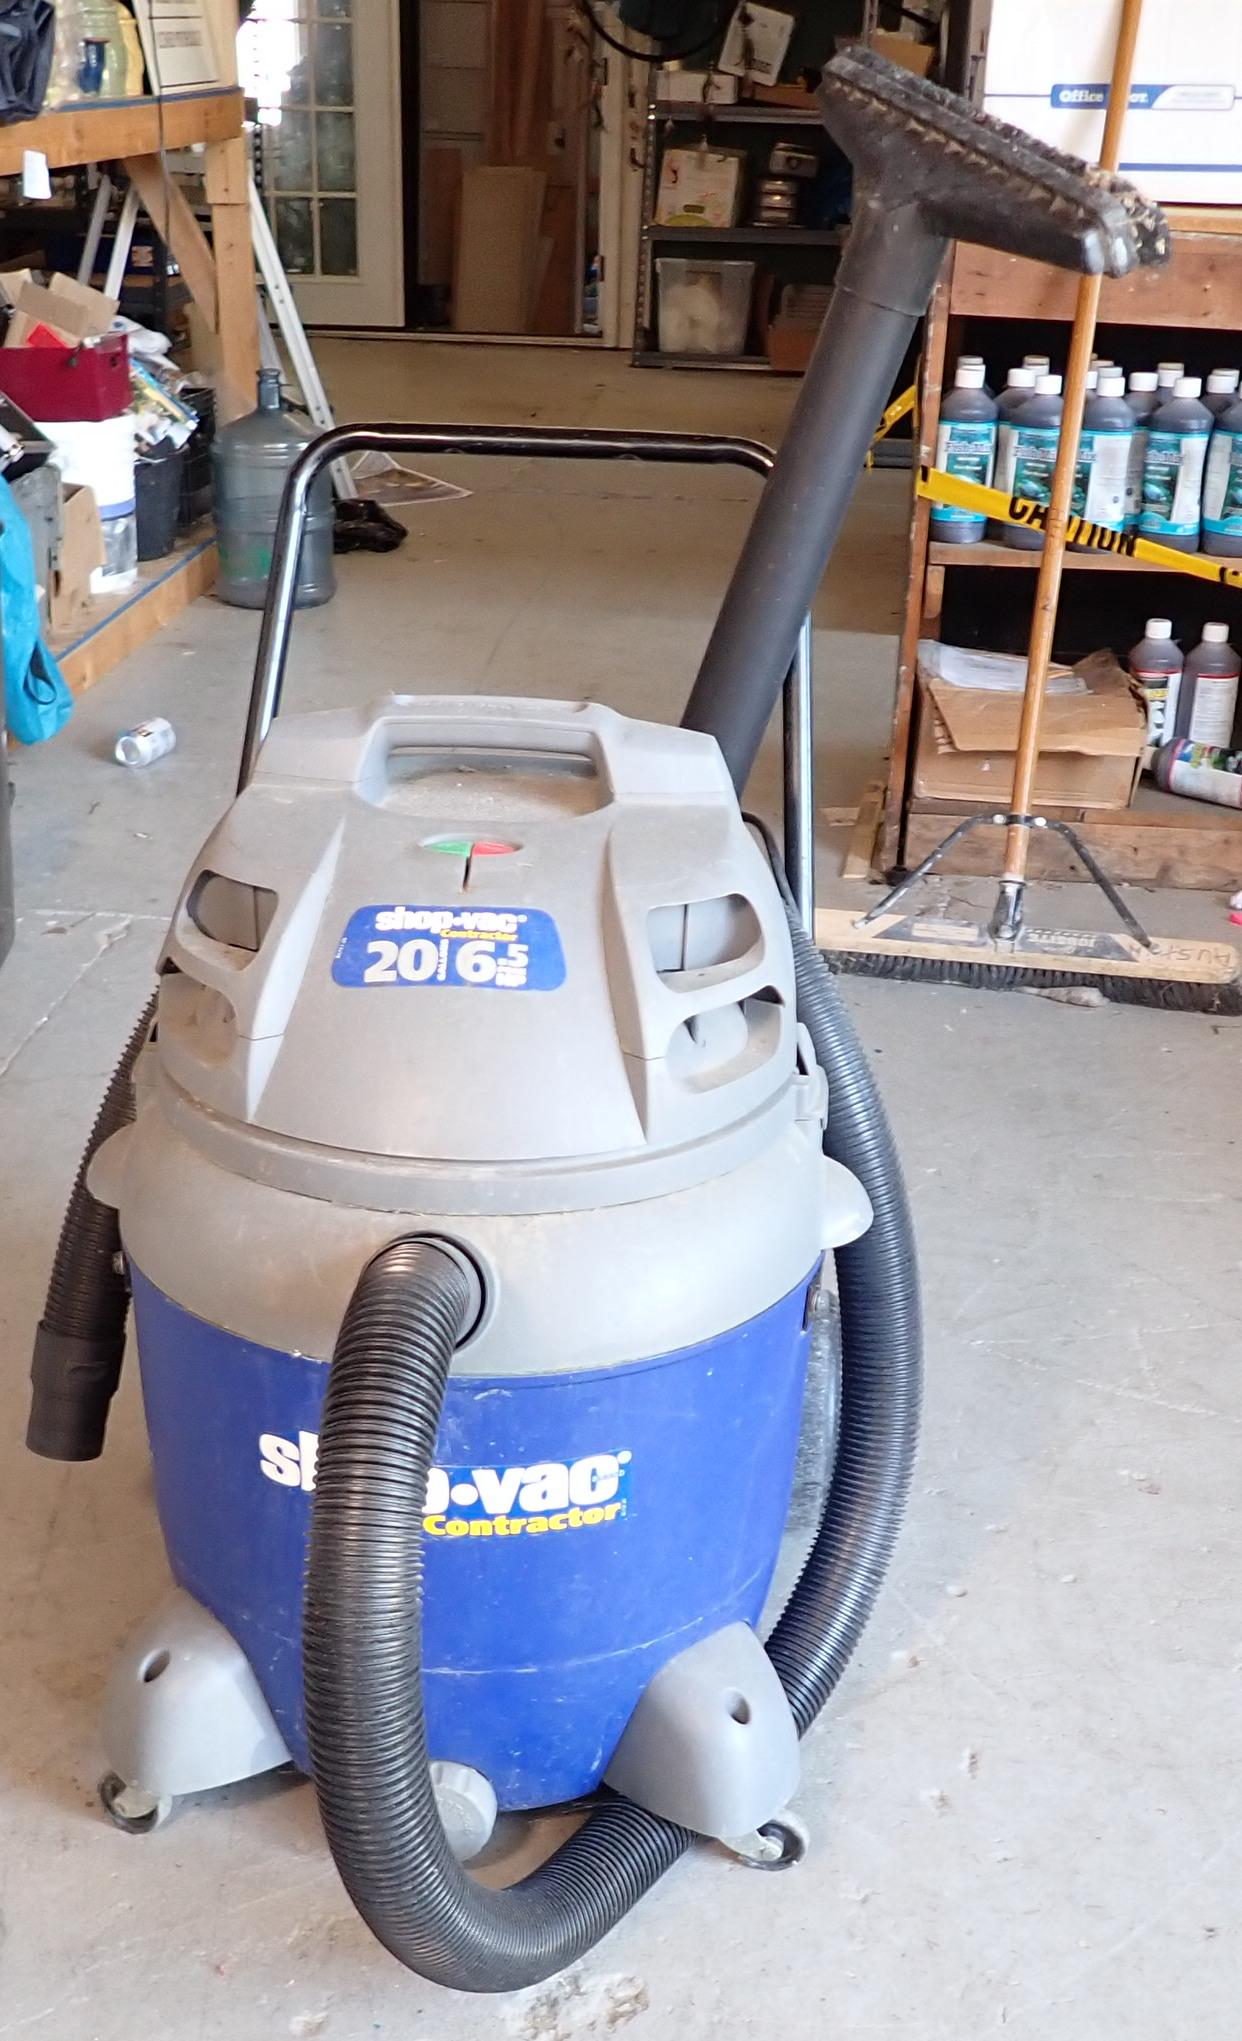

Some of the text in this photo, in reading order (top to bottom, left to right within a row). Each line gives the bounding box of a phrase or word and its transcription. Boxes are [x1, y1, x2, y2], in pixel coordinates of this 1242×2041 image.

[1059, 89, 1105, 103] Office
[1008, 496, 1137, 557] CATION
[364, 939, 439, 983] 20
[422, 1501, 622, 1537] Contractor
